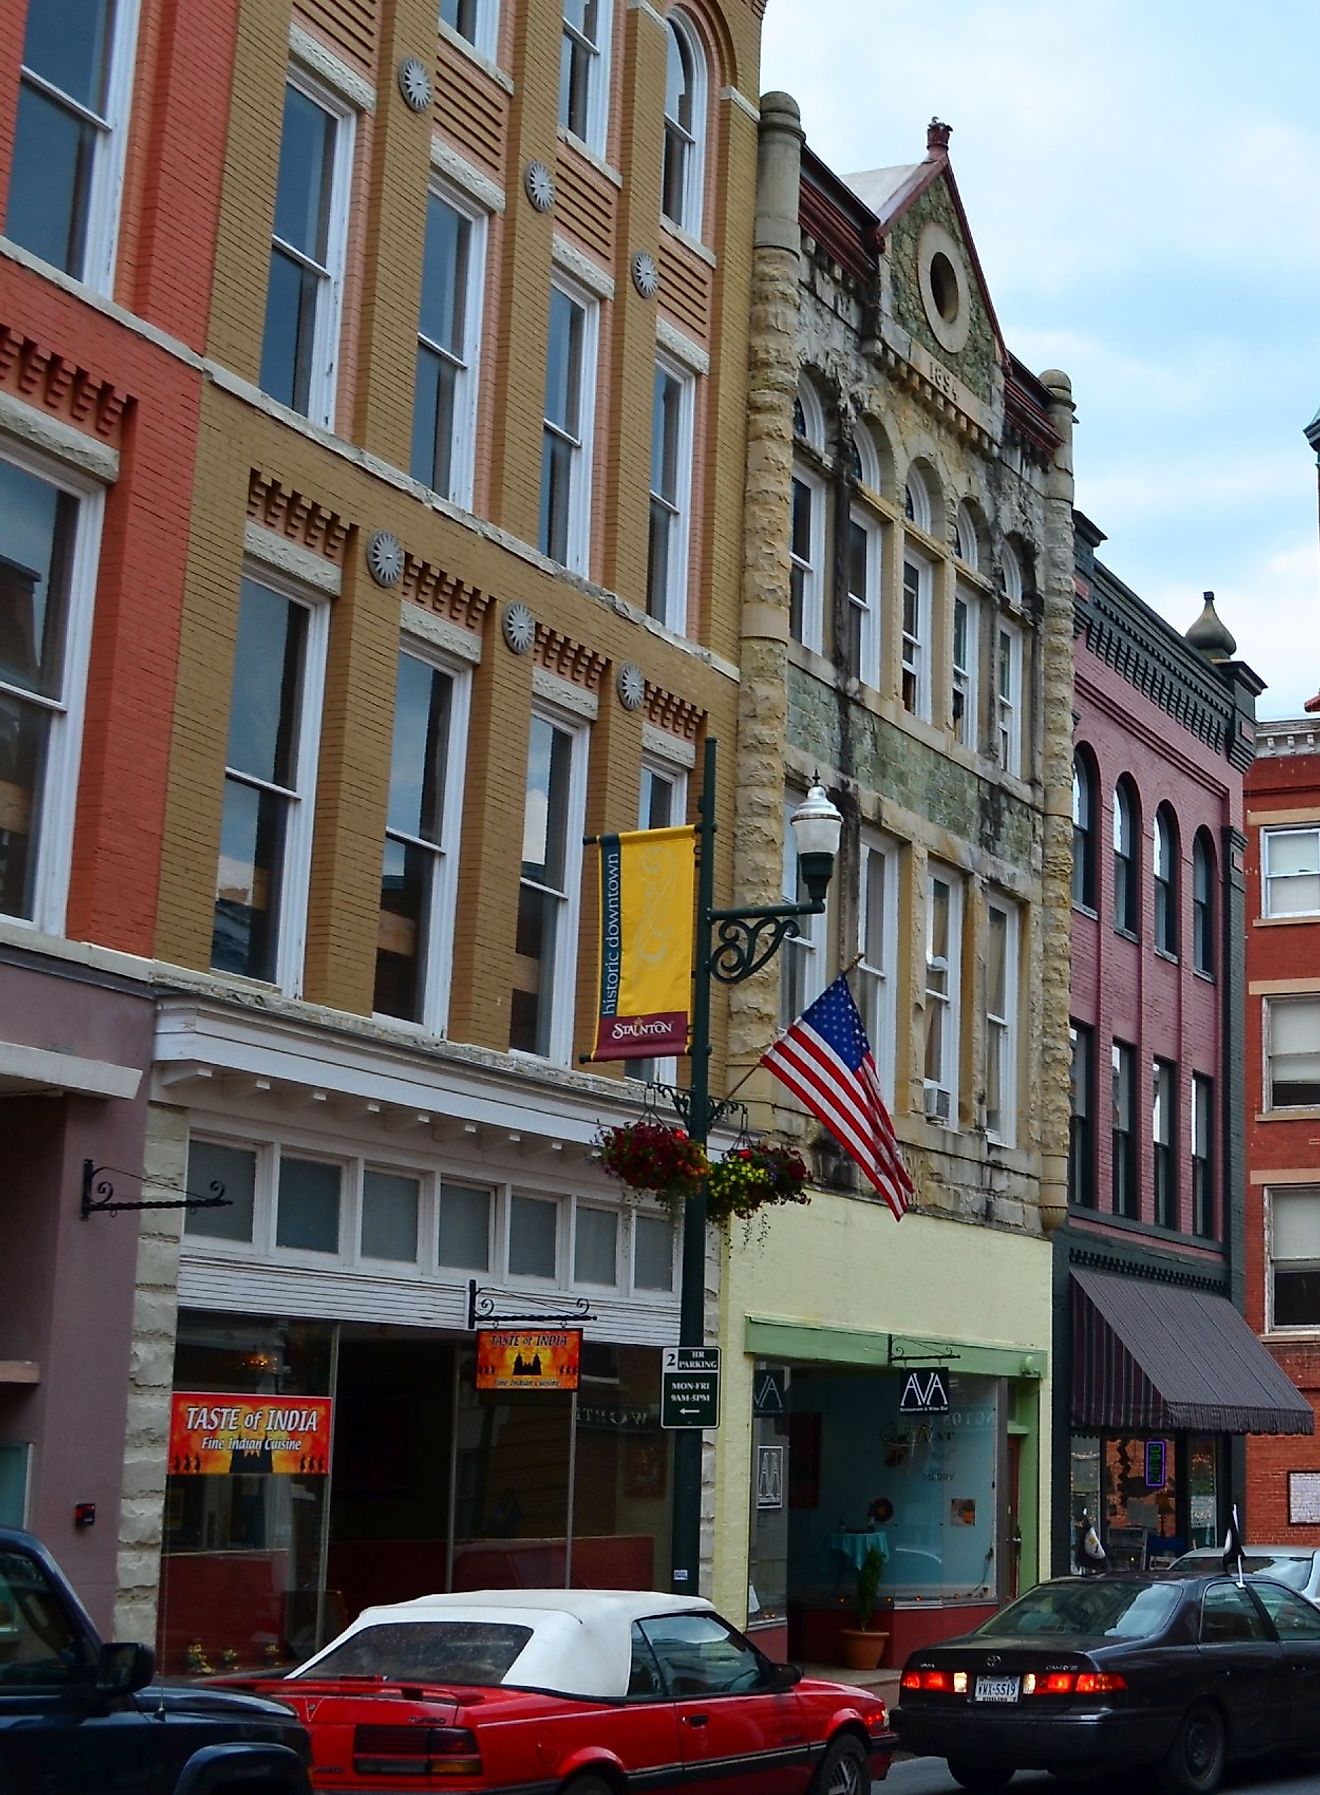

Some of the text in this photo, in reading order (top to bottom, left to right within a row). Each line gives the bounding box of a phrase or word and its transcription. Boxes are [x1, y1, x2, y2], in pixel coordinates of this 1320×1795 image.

[603, 853, 620, 1015] historic downtown
[612, 1021, 672, 1040] STAUNTON
[666, 1353, 676, 1367] 2
[671, 1382, 710, 1390] MON-FRI
[900, 1372, 949, 1406] AVA
[671, 1394, 710, 1402] 9AM-5PM
[186, 1406, 318, 1432] TASTE of INDIA
[201, 1435, 302, 1451] Fine Indian Cuisine
